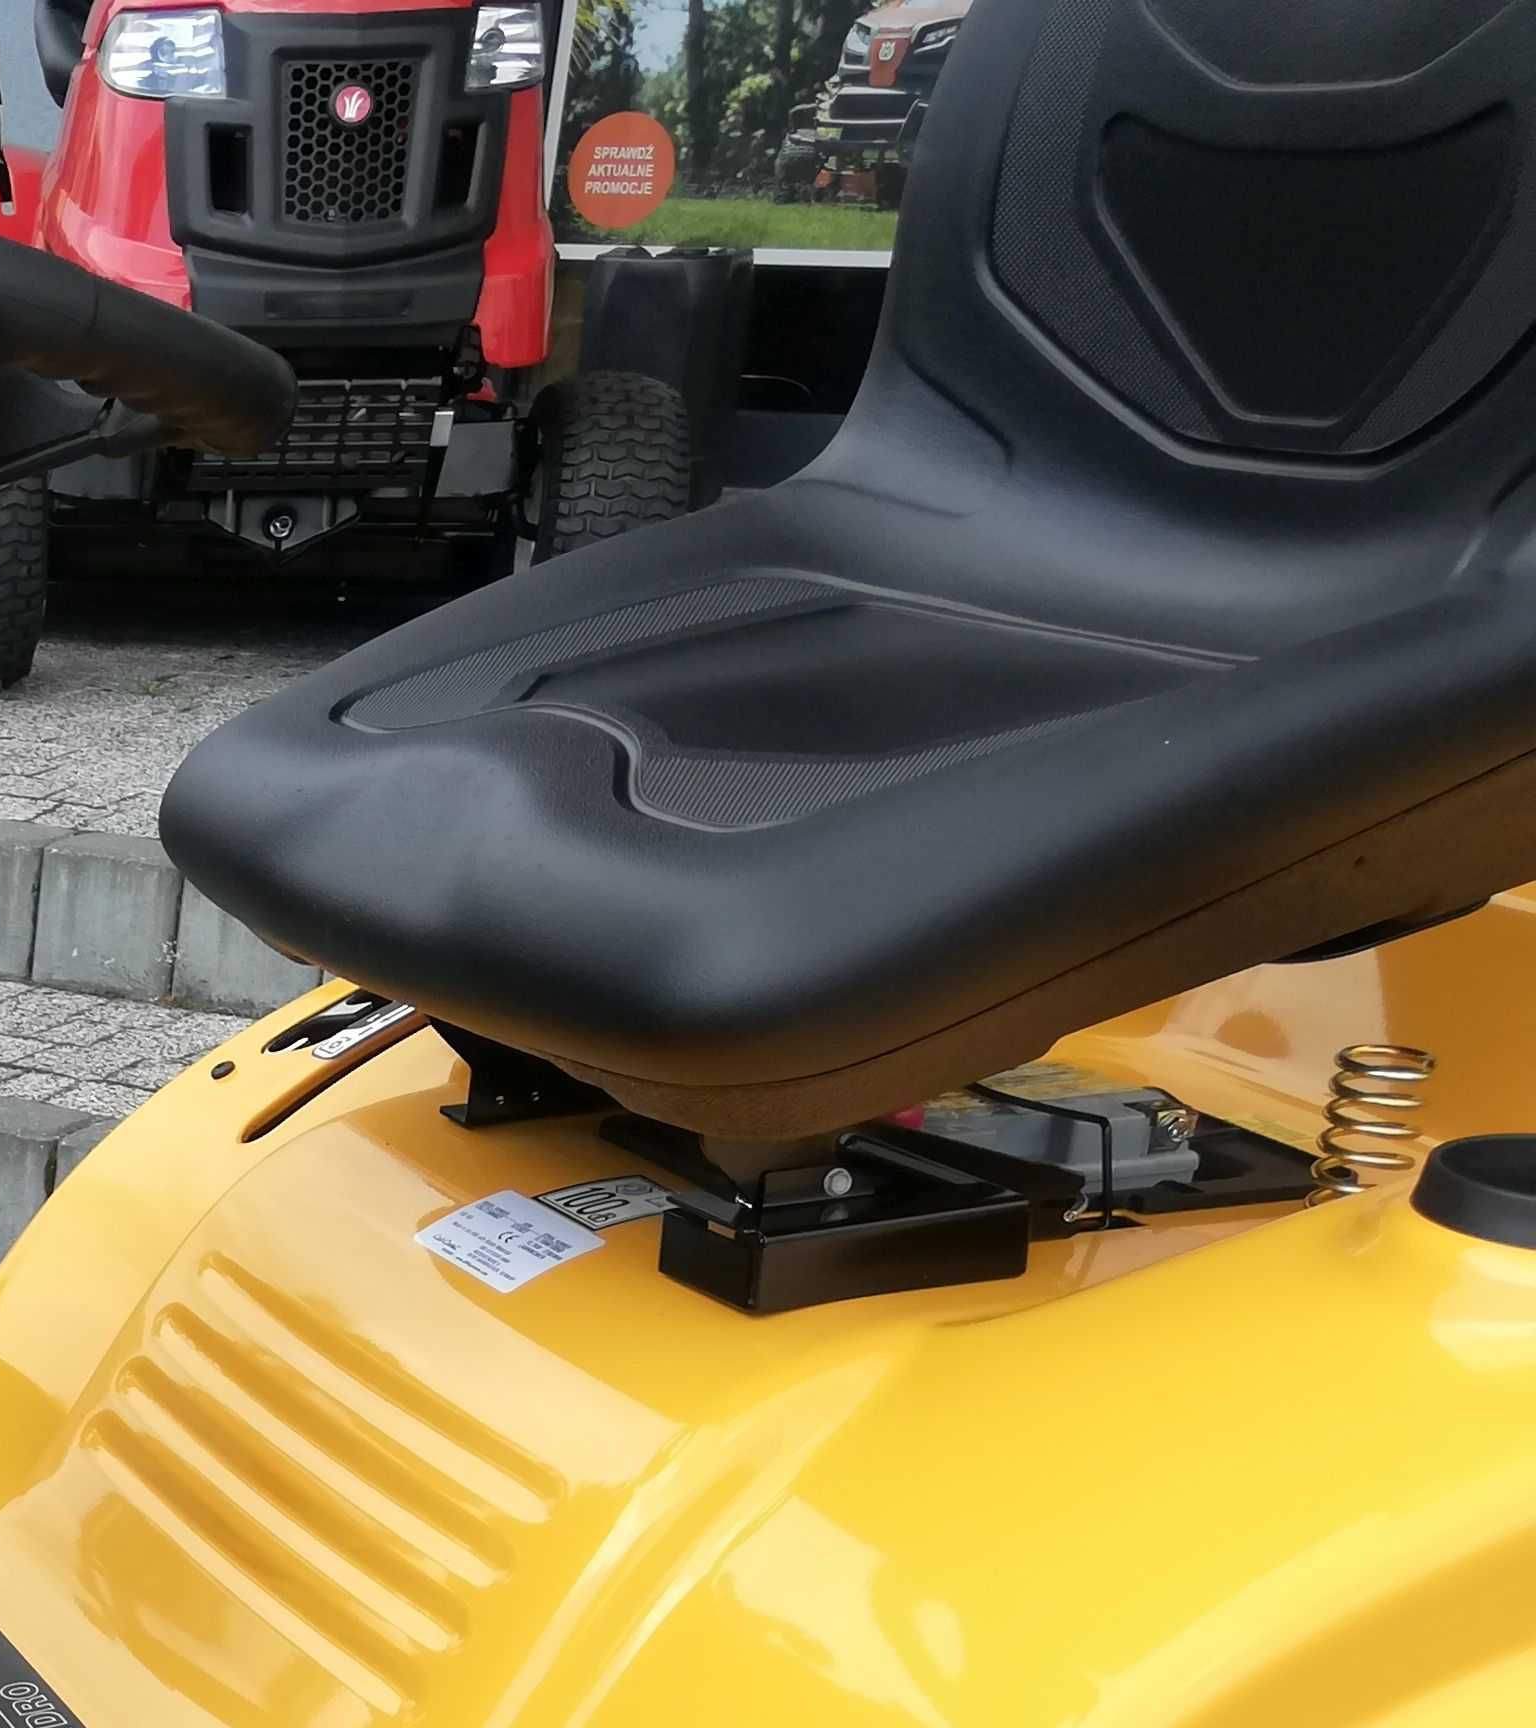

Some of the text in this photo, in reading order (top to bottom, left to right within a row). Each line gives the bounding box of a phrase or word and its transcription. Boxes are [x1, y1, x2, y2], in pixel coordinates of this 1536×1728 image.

[588, 164, 655, 177] AKTUALNE
[584, 181, 654, 195] PROMOCJE
[554, 1187, 631, 1215] 100
